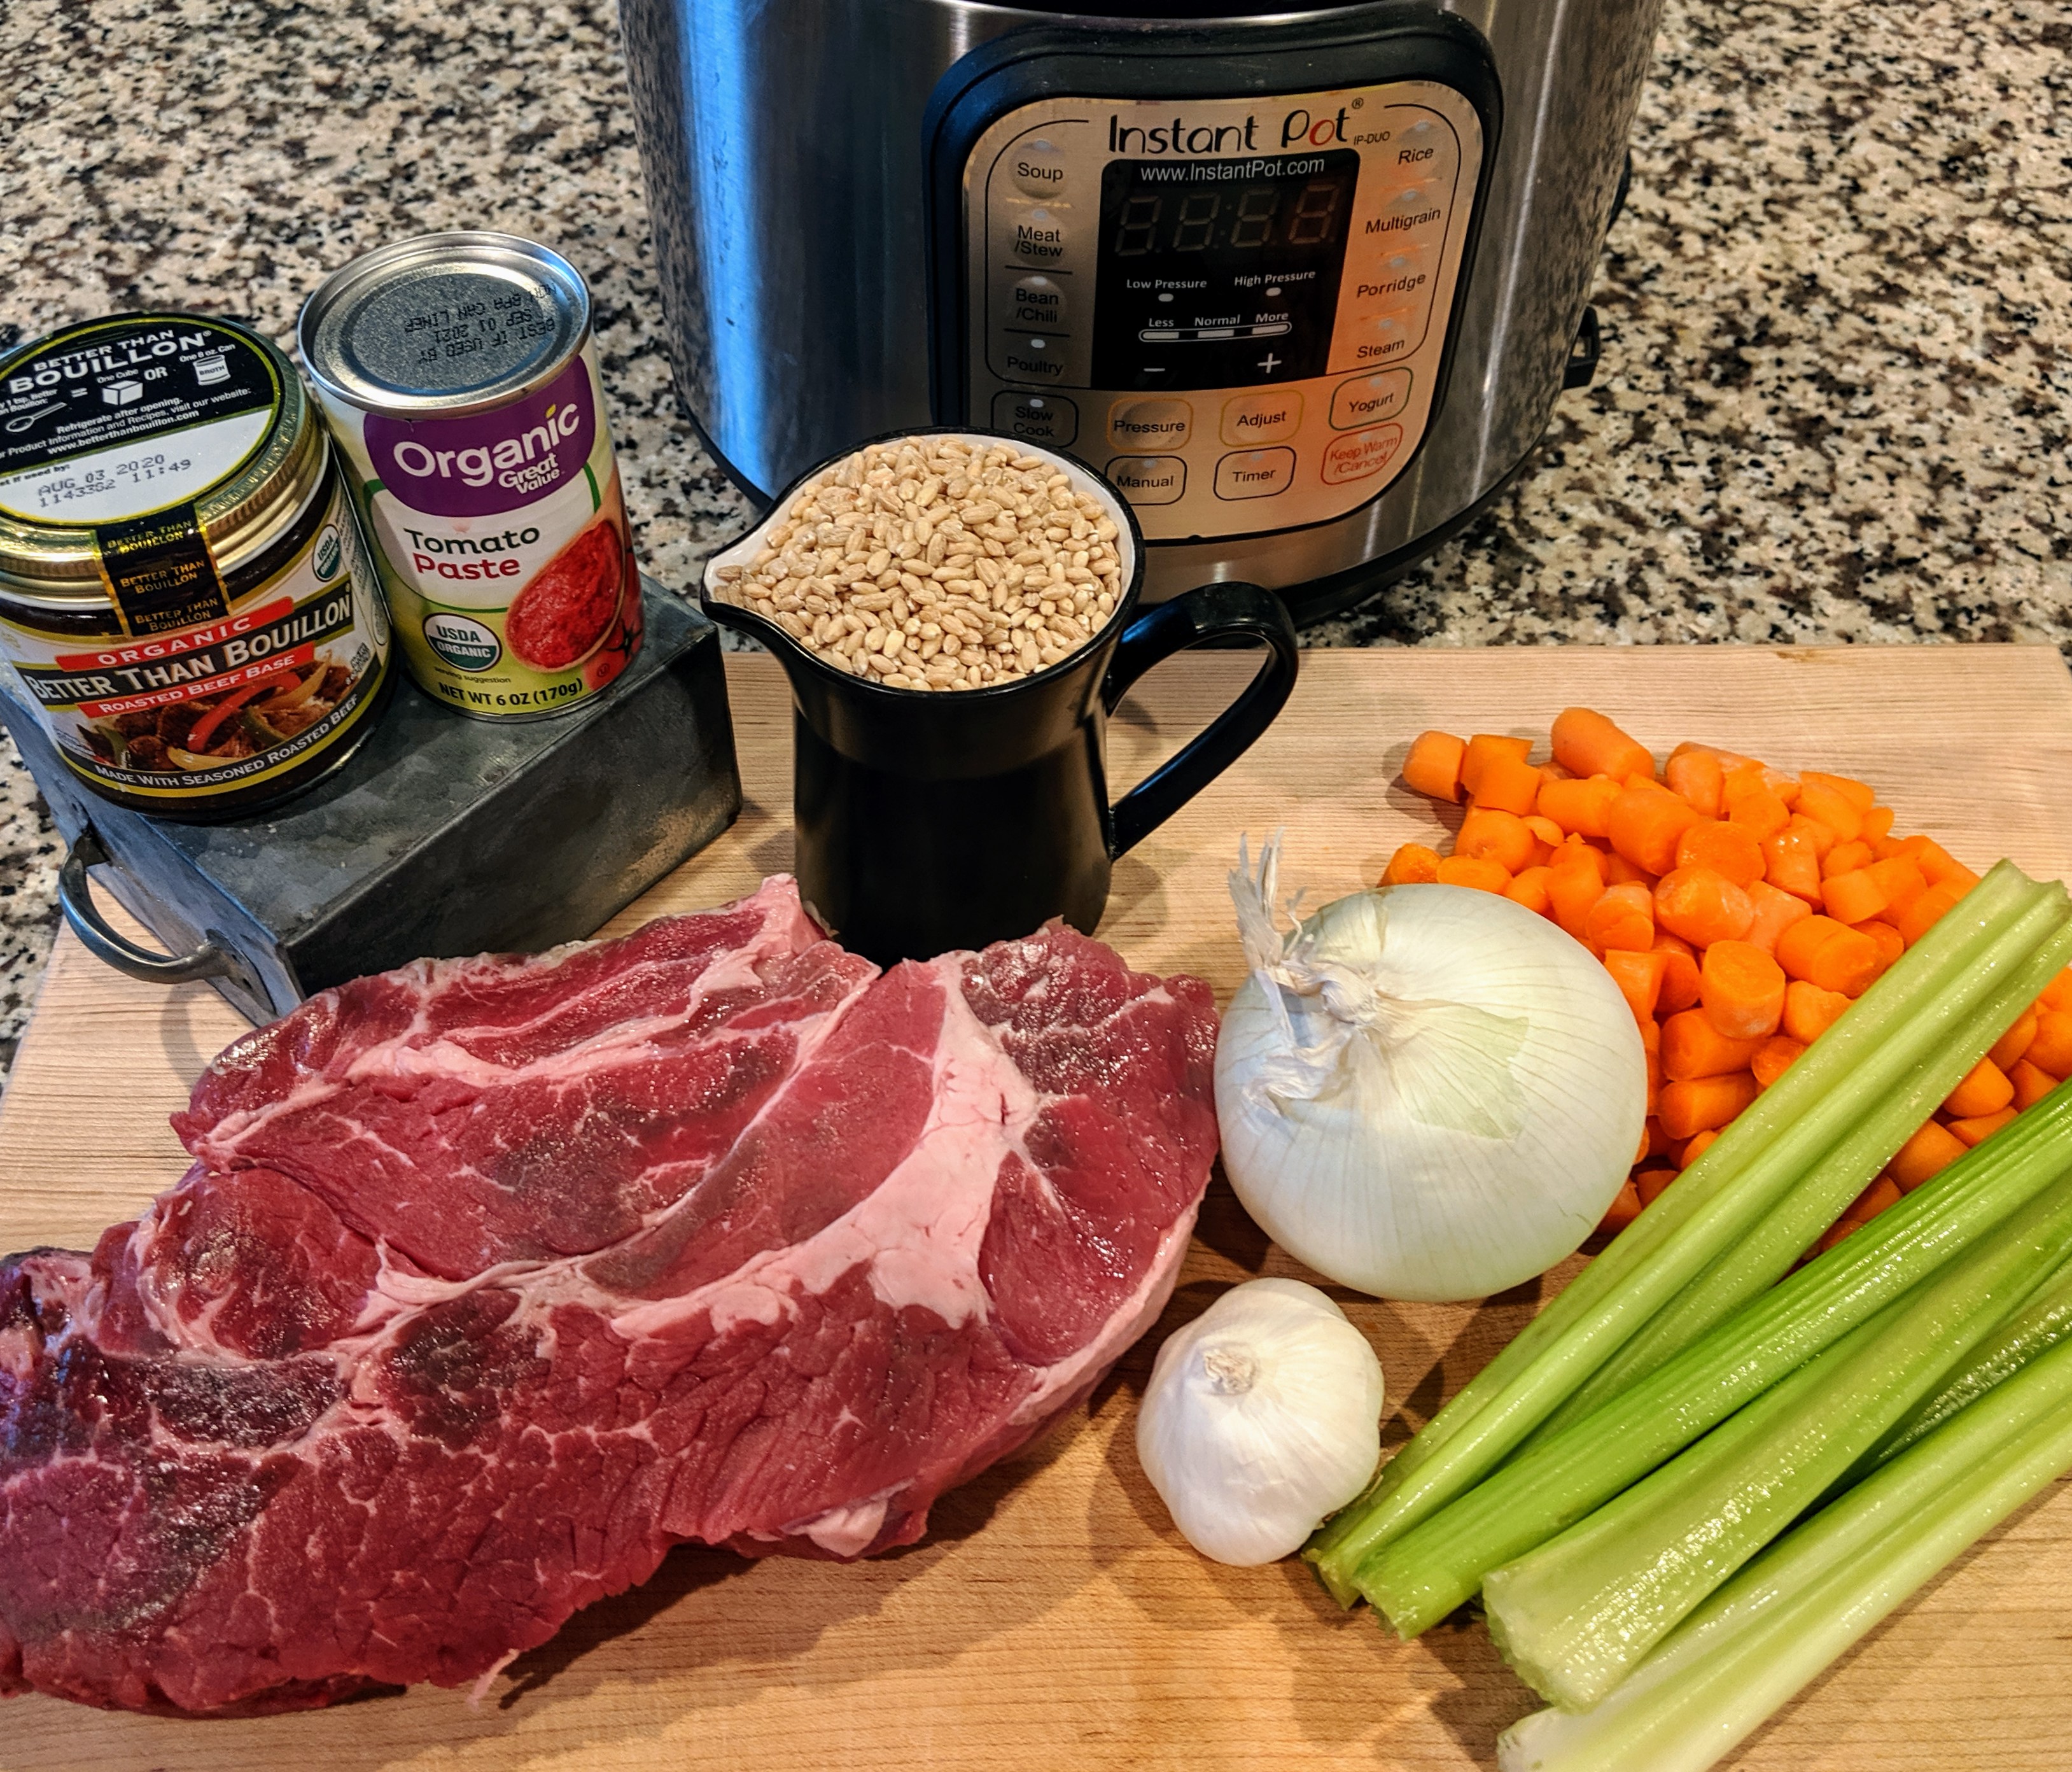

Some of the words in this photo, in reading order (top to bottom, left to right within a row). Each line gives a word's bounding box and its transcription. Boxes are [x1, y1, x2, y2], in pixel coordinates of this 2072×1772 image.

[1109, 115, 1259, 154] Instant
[1281, 108, 1350, 148] Pot
[1354, 131, 1390, 146] IP-DUO
[1398, 148, 1434, 165] Rice
[1018, 162, 1063, 183] Soup
[1140, 157, 1324, 181] www.InstantPot.com
[1366, 208, 1441, 234] Multigrain
[1018, 225, 1061, 242] Meat
[1014, 240, 1063, 257] /Stew
[1126, 279, 1151, 288] Low
[1155, 279, 1207, 288] Pressure
[1235, 276, 1261, 286] High
[1264, 271, 1315, 284] Pressure
[1357, 274, 1426, 297] Porridge
[1016, 288, 1059, 305] Bean
[458, 302, 486, 320] CAN
[506, 309, 532, 327] SEP
[1016, 307, 1058, 323] /Chili
[1194, 314, 1240, 326] Normal
[1256, 312, 1289, 323] More
[480, 318, 496, 332] 01
[519, 318, 556, 340] BEST
[1149, 318, 1174, 327] Less
[434, 324, 469, 344] 2021
[493, 330, 508, 347] IF
[33, 346, 113, 371] BETTER
[117, 330, 174, 349] THAN
[179, 354, 197, 363] One
[218, 343, 236, 353] Can
[418, 347, 438, 363] BY
[447, 338, 483, 357] USED
[1357, 340, 1404, 358] Steam
[144, 367, 168, 381] OR
[199, 365, 225, 376] BROTH
[1007, 356, 1064, 376] Poultry
[97, 374, 115, 384] One
[116, 369, 139, 379] Cube
[1349, 393, 1394, 412] Yogurt
[8, 440, 47, 456] Product
[48, 425, 105, 446] Information
[106, 419, 125, 431] and
[170, 402, 191, 414] visit
[192, 398, 210, 408] our
[211, 388, 251, 404] website:
[56, 414, 113, 435] Refrigerate
[115, 407, 138, 422] after
[141, 396, 183, 412] opening.
[1015, 406, 1054, 421] Slow
[1236, 411, 1287, 428] Adjust
[47, 410, 200, 454] www.betterthanbouillon.com
[1014, 422, 1054, 437] Cook
[1114, 420, 1186, 433] Pressure
[393, 404, 580, 487] Organic
[1331, 448, 1361, 461] Keep
[1364, 437, 1398, 454] Warm
[38, 478, 76, 496] AUG
[85, 469, 105, 484] 03
[116, 454, 165, 475] 2020
[132, 458, 191, 483] 11:49
[498, 453, 558, 488] Great
[1232, 469, 1277, 484] Timer
[515, 468, 560, 494] Value
[1117, 475, 1174, 488] Manual
[108, 530, 154, 549] BETTER
[159, 520, 192, 533] THAN
[119, 530, 184, 554] BOUILLON
[403, 527, 540, 554] Tomato
[318, 534, 334, 561] USDA
[120, 570, 167, 588] BETTER
[171, 559, 205, 575] THAN
[413, 552, 521, 580] Paste
[135, 572, 198, 594] BOUILLON
[135, 610, 181, 624] BETTER
[188, 598, 218, 612] THAN
[150, 610, 211, 631] BOUILLON
[97, 617, 252, 665] ORGANIC
[436, 624, 482, 643] USDA
[24, 675, 118, 699] BETTER
[114, 654, 216, 691] THAN
[223, 594, 351, 668] BOUILLON
[436, 641, 492, 658] ORGANIC
[99, 690, 184, 712] ROASTED
[187, 673, 241, 695] BEEF
[246, 654, 295, 679] BASE
[464, 674, 512, 684] suggestion
[438, 682, 465, 701] NET
[468, 690, 491, 705] WT
[496, 694, 507, 706] 6
[509, 693, 531, 705] OZ
[533, 678, 583, 705] (170g)
[95, 765, 137, 784] MADE
[137, 774, 179, 786] WITH
[181, 759, 265, 786] SEASONED
[267, 722, 330, 764] ROASTED
[330, 694, 358, 726] BEEF
